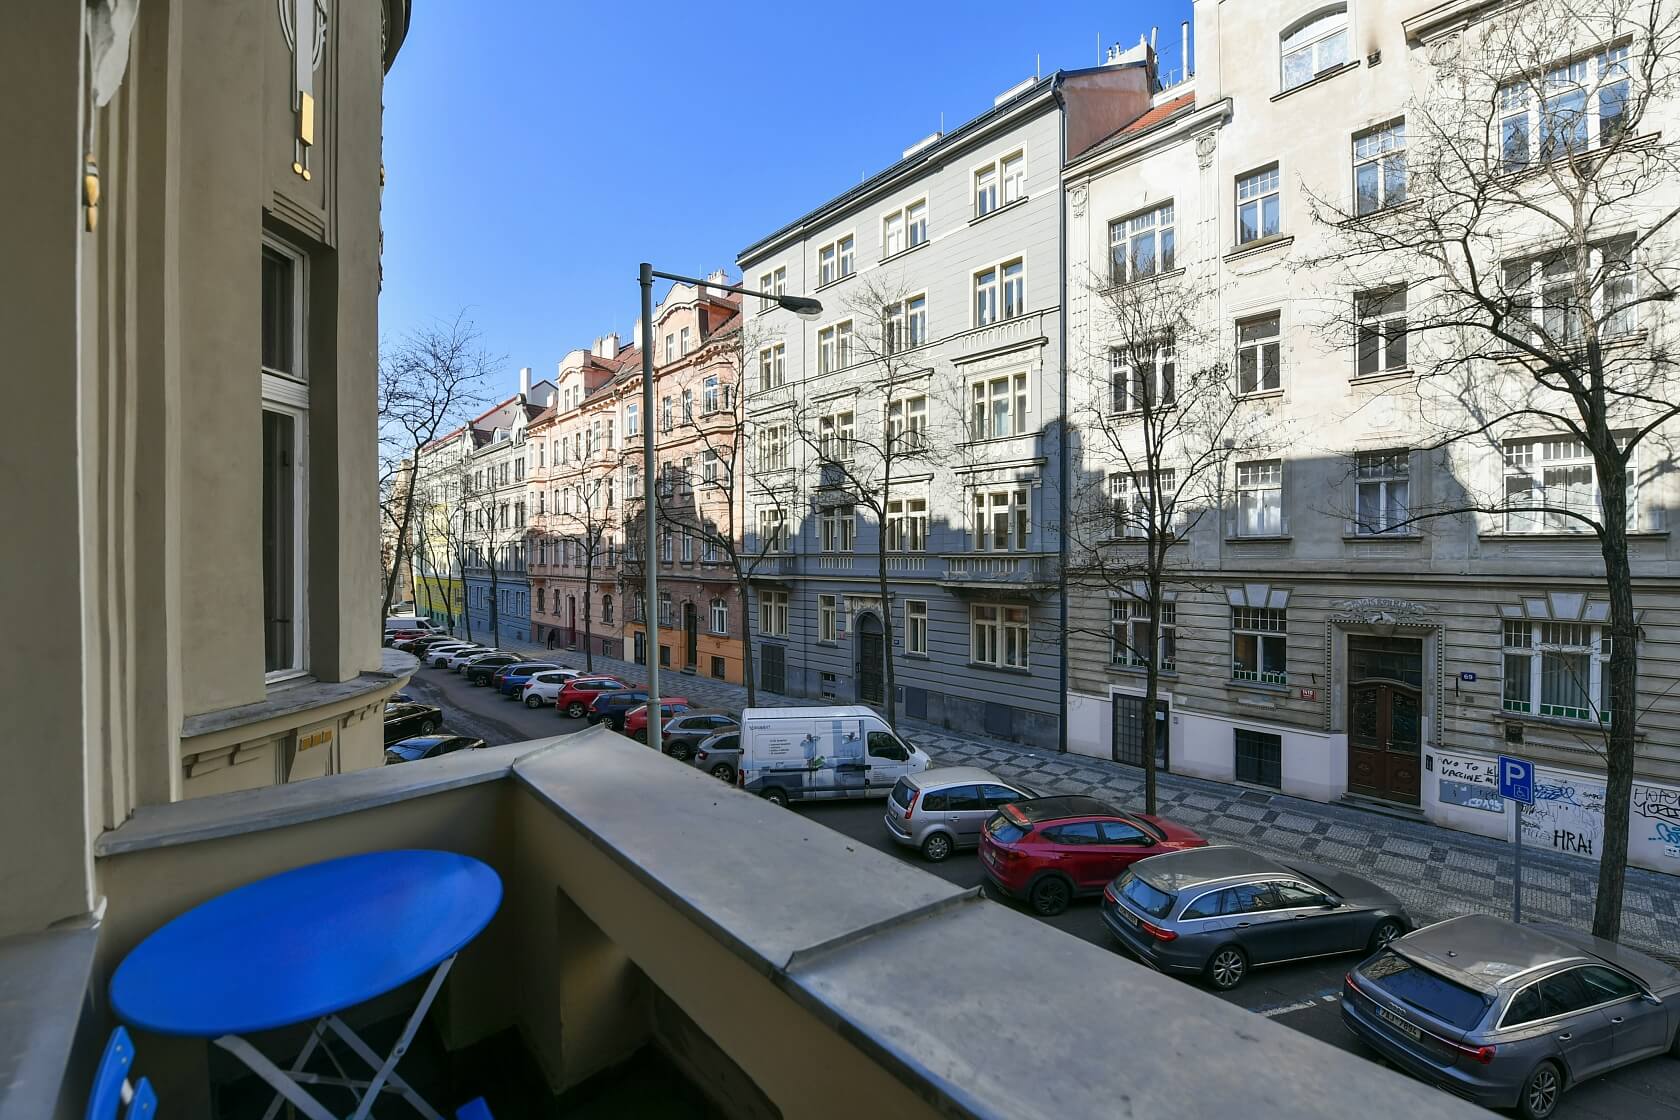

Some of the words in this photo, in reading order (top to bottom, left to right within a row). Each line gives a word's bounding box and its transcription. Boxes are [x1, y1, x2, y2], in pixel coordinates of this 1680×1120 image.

[1442, 758, 1459, 767] NO
[1464, 762, 1479, 771] TO
[1505, 761, 1526, 786] P
[1553, 829, 1593, 855] HRA!
